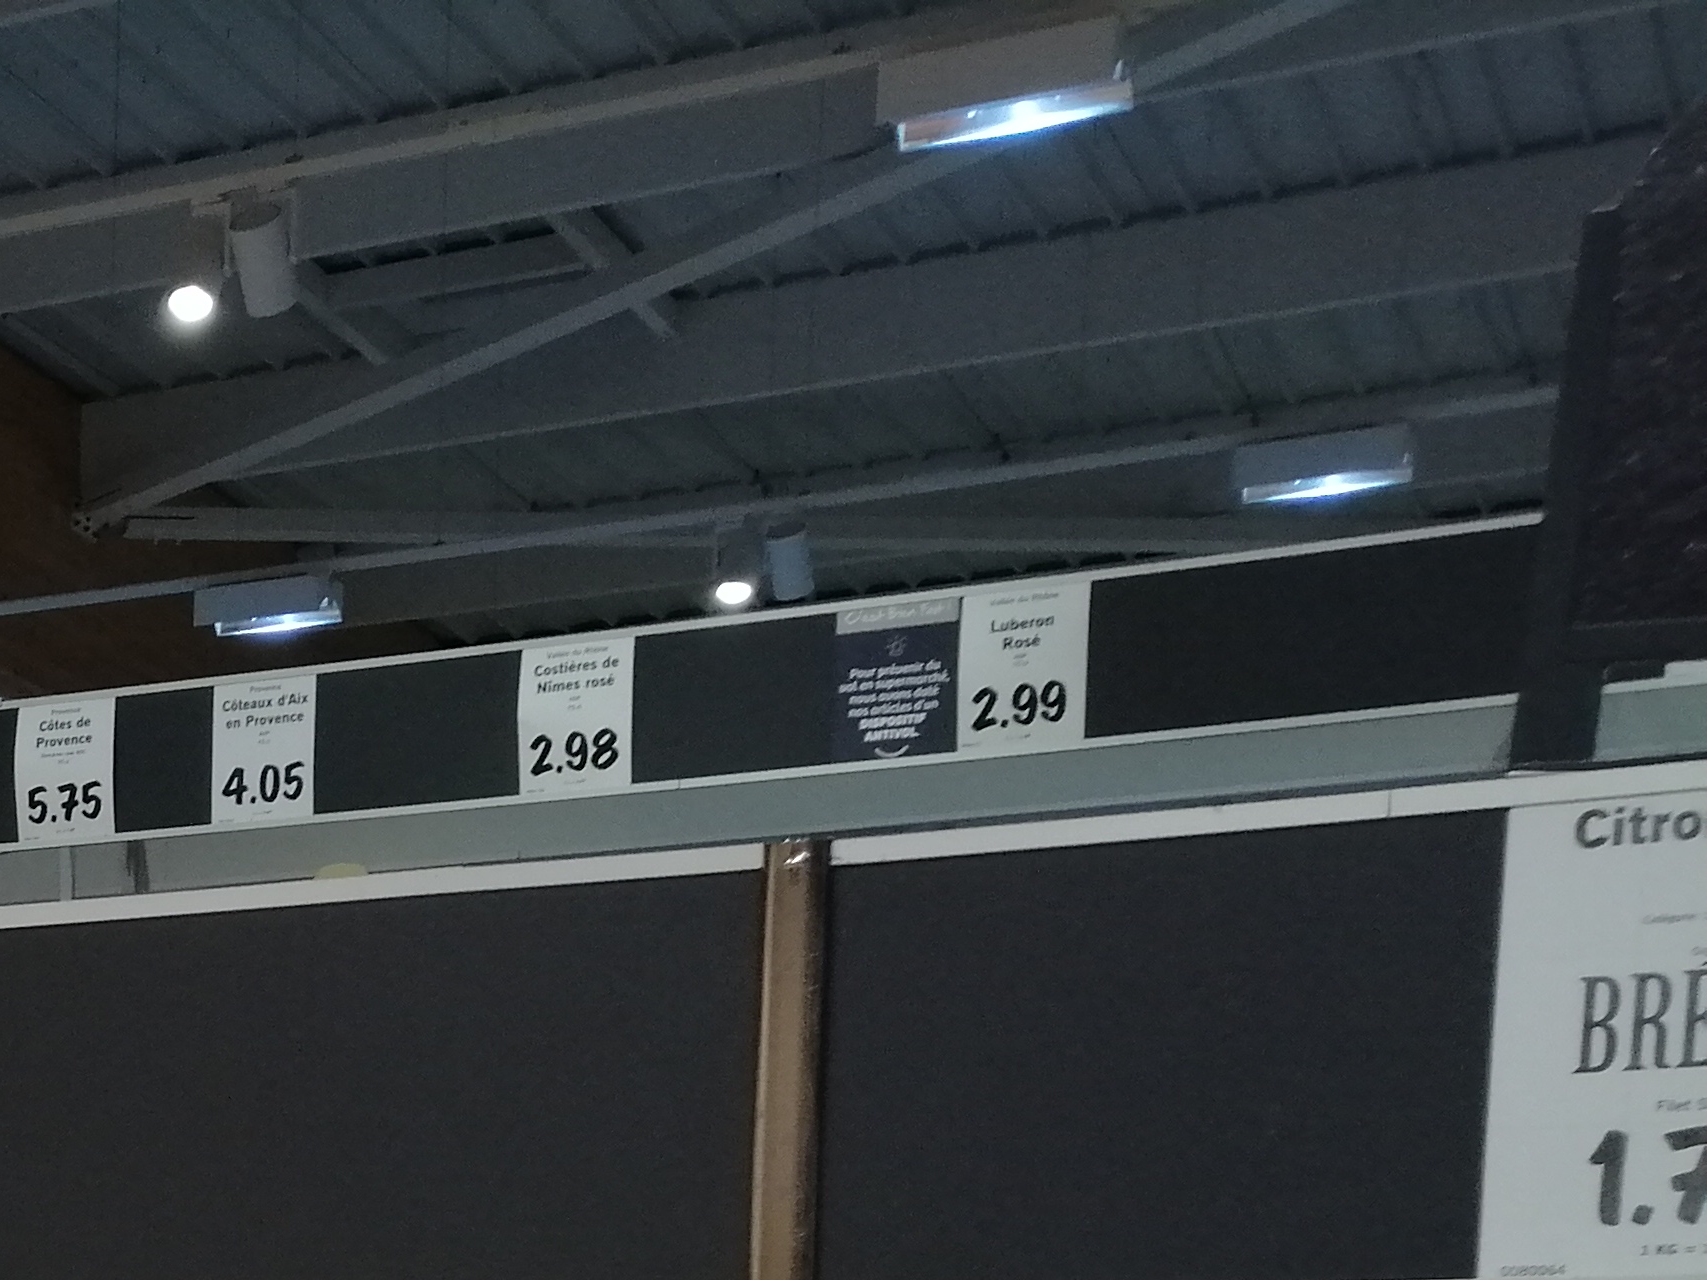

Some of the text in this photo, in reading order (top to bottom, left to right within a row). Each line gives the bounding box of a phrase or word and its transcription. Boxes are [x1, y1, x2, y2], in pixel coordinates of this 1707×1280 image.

[991, 613, 1054, 634] Luberon
[1002, 632, 1041, 650] Rosé
[533, 655, 620, 678] Costières de
[537, 671, 615, 694] Nîmes rosé
[971, 679, 1068, 732] 2.99
[39, 716, 91, 732] Côtes de
[226, 710, 305, 730] en Provence
[36, 733, 92, 749] Provence
[529, 728, 620, 776] 2.98
[222, 761, 305, 806] 4.05
[27, 780, 103, 825] 5.75
[1574, 806, 1707, 849] Citro
